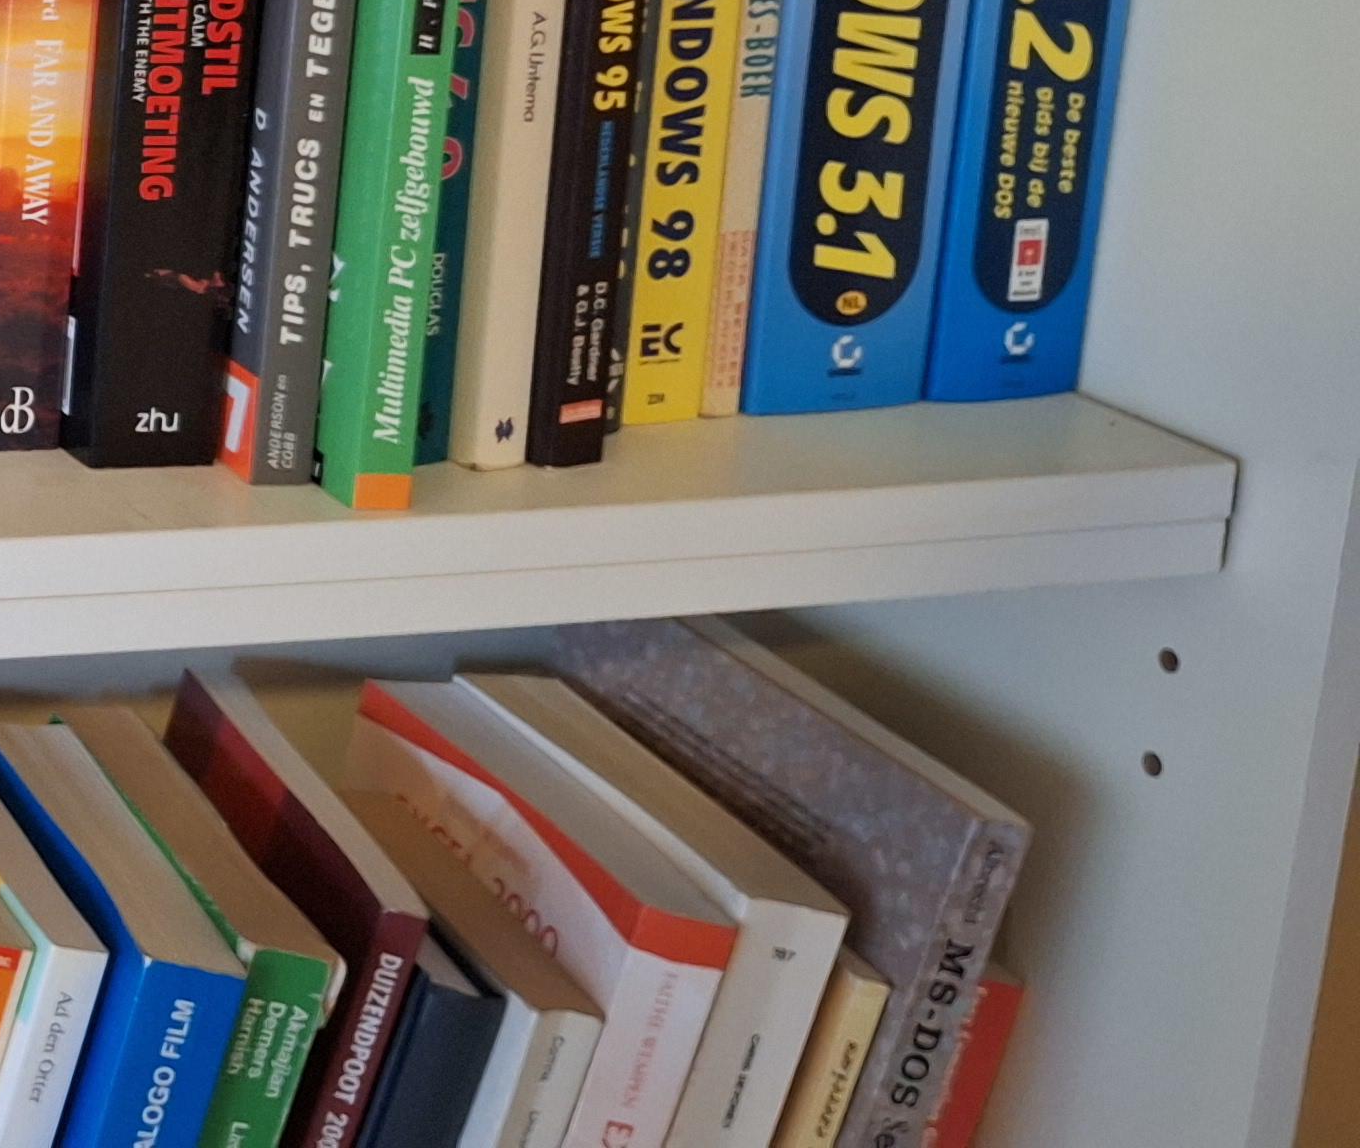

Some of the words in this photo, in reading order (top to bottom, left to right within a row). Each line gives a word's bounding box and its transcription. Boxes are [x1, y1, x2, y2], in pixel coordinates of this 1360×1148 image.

[135, 17, 151, 48] THE
[189, 3, 208, 48] CALM
[131, 49, 148, 103] ENEMY
[592, 66, 629, 112] 95
[20, 154, 53, 227] AWAY
[289, 138, 322, 248] TRUCS
[307, 93, 326, 123] EN
[646, 208, 695, 282] 98
[813, 159, 906, 280] 3.1
[372, 293, 415, 445] Multimedia
[394, 76, 436, 242] zelfgebouwd
[53, 990, 75, 1019] Ad
[160, 998, 197, 1062] FILM
[332, 951, 406, 1104] DUIZENDPOOT
[889, 937, 977, 1109] MS-DOS
[45, 1022, 66, 1057] den
[247, 1000, 288, 1080] Demers
[28, 1059, 55, 1104] Otter
